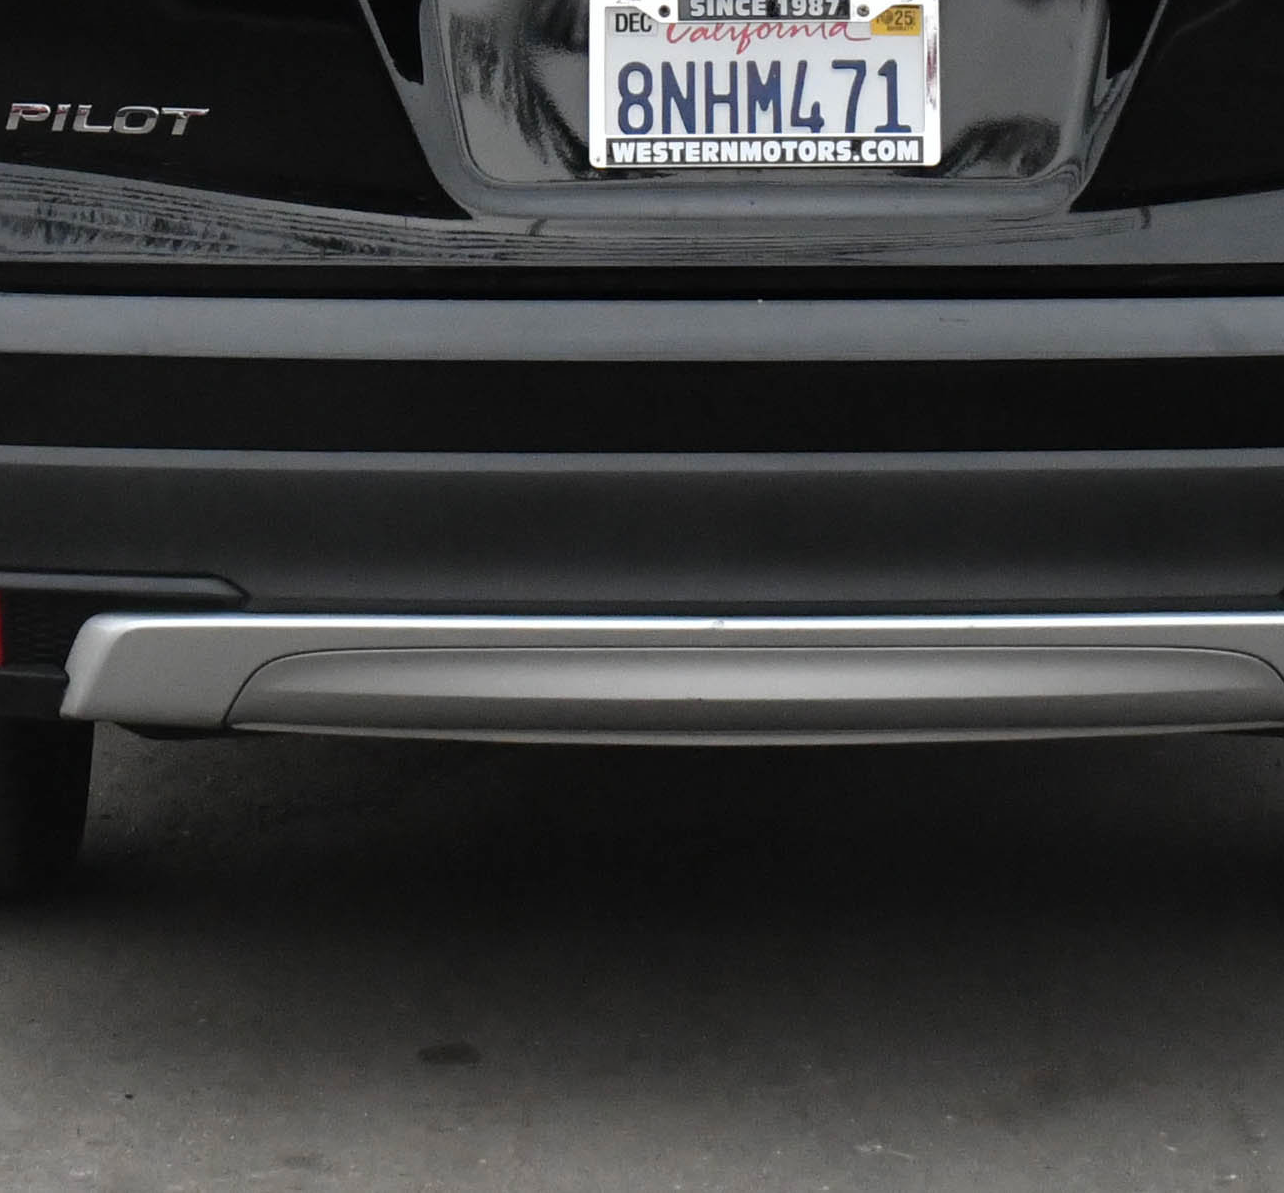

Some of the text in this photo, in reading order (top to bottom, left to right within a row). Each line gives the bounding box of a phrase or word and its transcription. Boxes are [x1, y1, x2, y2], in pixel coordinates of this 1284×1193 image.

[615, 12, 653, 33] DEC
[894, 9, 914, 26] 25
[617, 59, 913, 135] 8NHM471
[5, 102, 210, 136] PILOT
[611, 140, 920, 164] WESTERNMOTORS.COM
